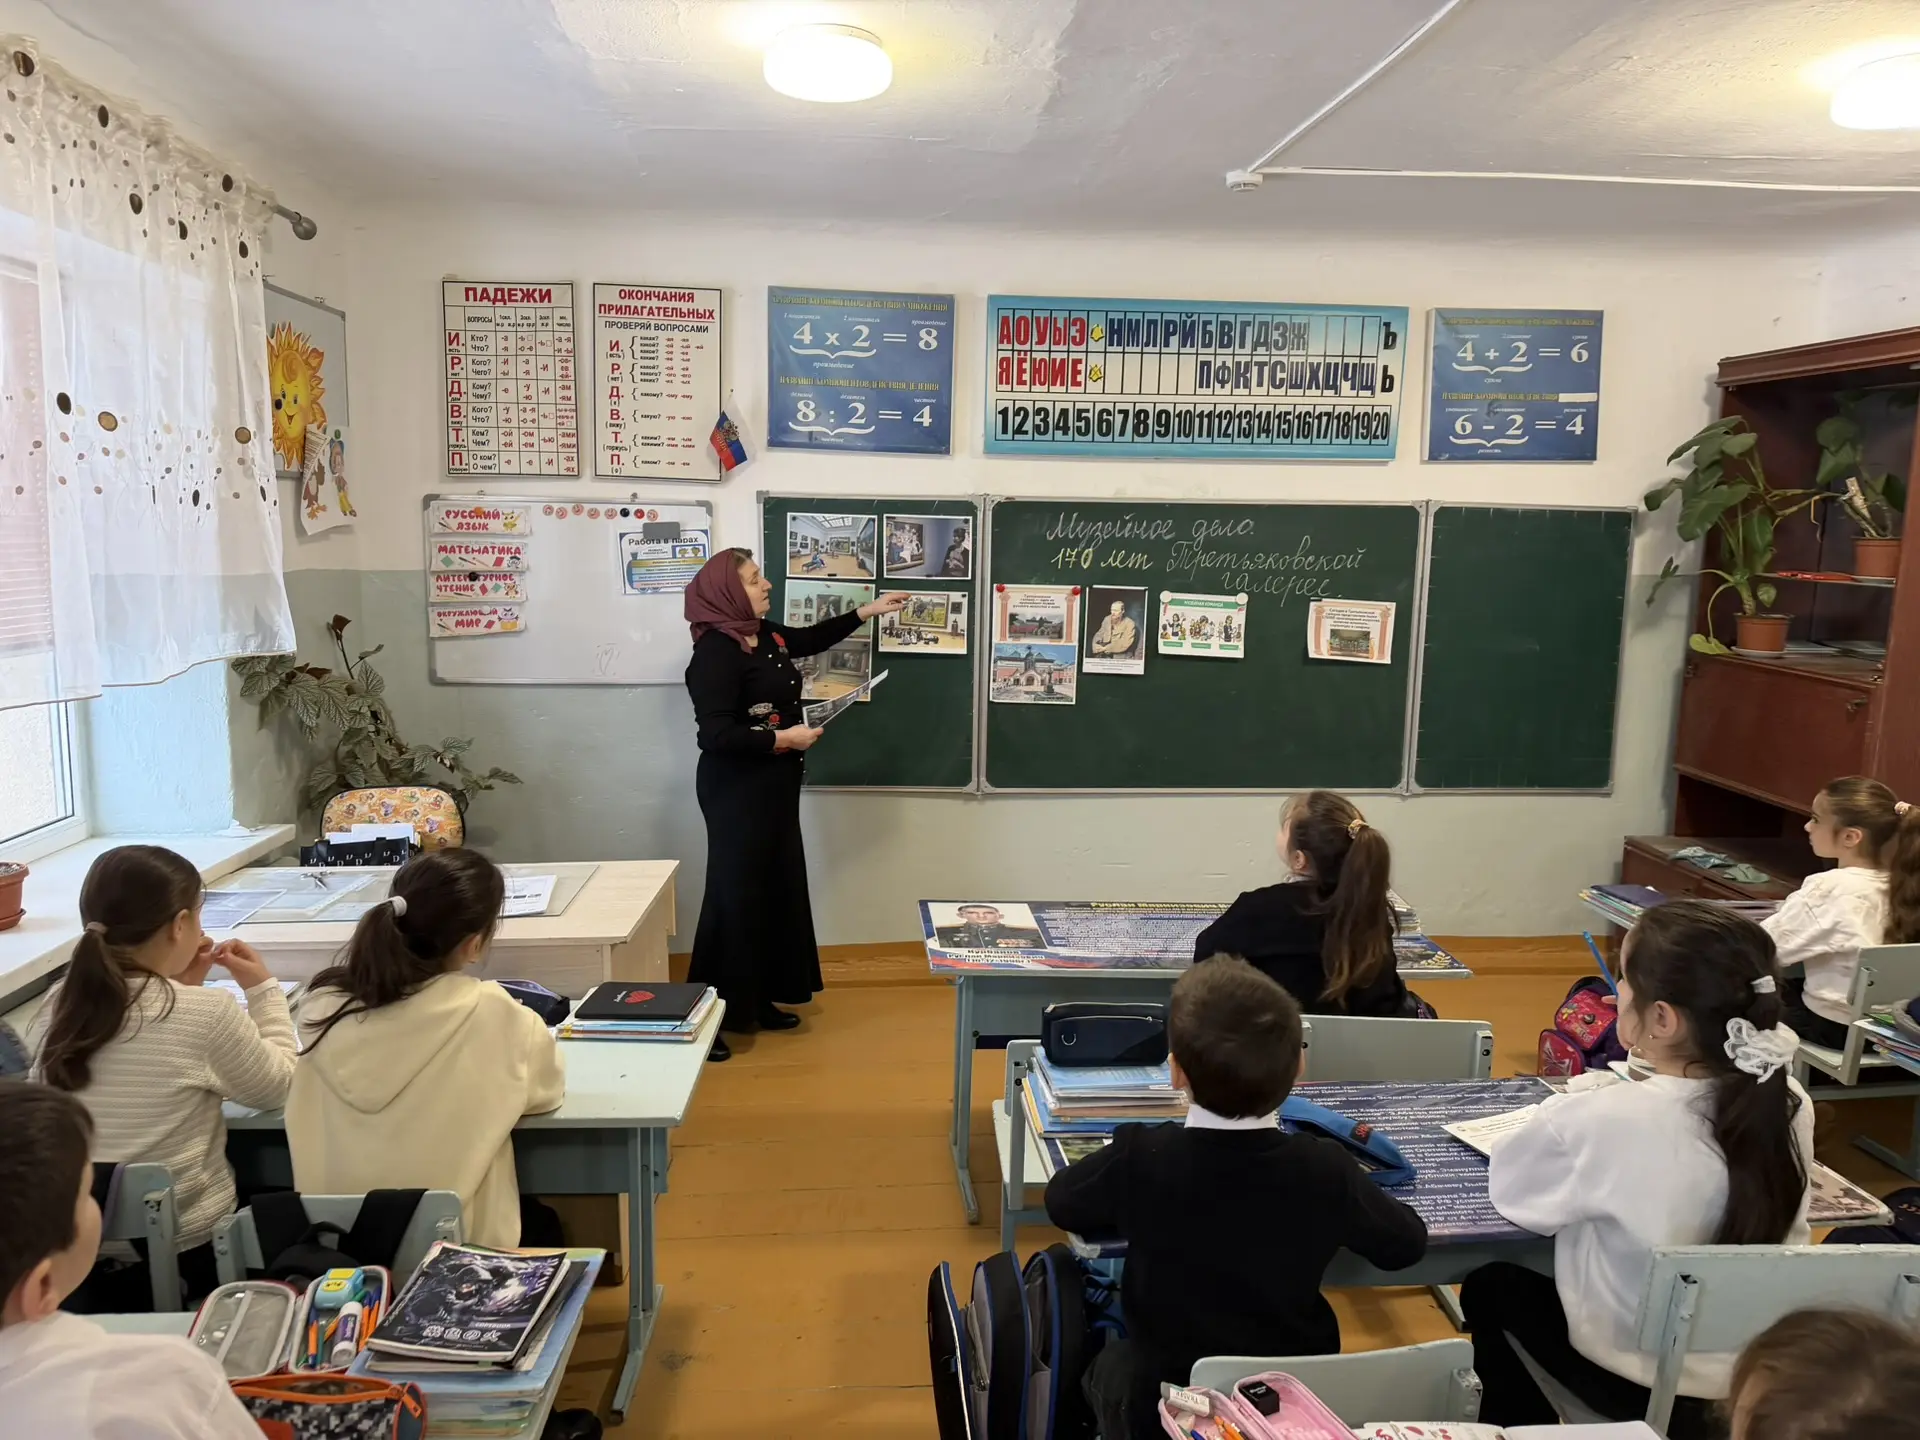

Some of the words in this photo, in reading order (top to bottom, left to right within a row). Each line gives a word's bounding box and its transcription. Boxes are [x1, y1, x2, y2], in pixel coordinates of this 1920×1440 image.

[464, 287, 552, 305] ПАДЕЖИ
[619, 289, 694, 303] ОКОНЧАНИЯ
[599, 304, 714, 320] ПРИЛАГАТЕЛЬНЫХ
[605, 320, 651, 330] ПРОВЕРЯЙ
[654, 323, 709, 333] ВОПРОСАМИ
[793, 322, 812, 344] 4
[852, 325, 870, 347] 2
[919, 328, 937, 350] 8
[1457, 341, 1474, 361] 4
[1510, 342, 1527, 362] 2
[1571, 342, 1589, 362] 6
[472, 383, 492, 391] Кому?
[797, 400, 816, 422] 8
[848, 403, 866, 423] 2
[913, 406, 932, 426] 4
[998, 407, 1009, 434] 1
[1015, 407, 1029, 435] 2
[1035, 407, 1049, 435] 3
[1055, 408, 1070, 436] 4
[1076, 409, 1090, 436] 5
[1097, 409, 1112, 437] 6
[1117, 409, 1129, 437] 7
[1135, 409, 1149, 438] 8
[1156, 409, 1171, 438] 9
[1176, 410, 1192, 438] 10
[1196, 410, 1213, 438] 11
[1216, 410, 1232, 438] 12
[1236, 410, 1252, 439] 13
[1257, 411, 1272, 439] 14
[1276, 411, 1292, 439] 15
[1296, 411, 1311, 439] 16
[1315, 412, 1332, 439] 17
[1335, 412, 1351, 439] 18
[1354, 412, 1370, 439] 19
[1373, 412, 1388, 440] 20
[1455, 414, 1472, 434] 6
[1505, 415, 1523, 435] 2
[1566, 415, 1584, 434] 4
[456, 522, 489, 530] ЯЗЫК
[1047, 512, 1176, 550] Музейное
[1051, 548, 1093, 569] 170
[1101, 550, 1153, 570] лет
[1167, 535, 1366, 581] Третьяковской
[436, 573, 514, 581] ЛИТЕРТУРНОЕ
[437, 584, 475, 592] ЧТЕНИЕ
[437, 608, 498, 617] ОКРУЖАЮЙ
[455, 619, 481, 628] МИР
